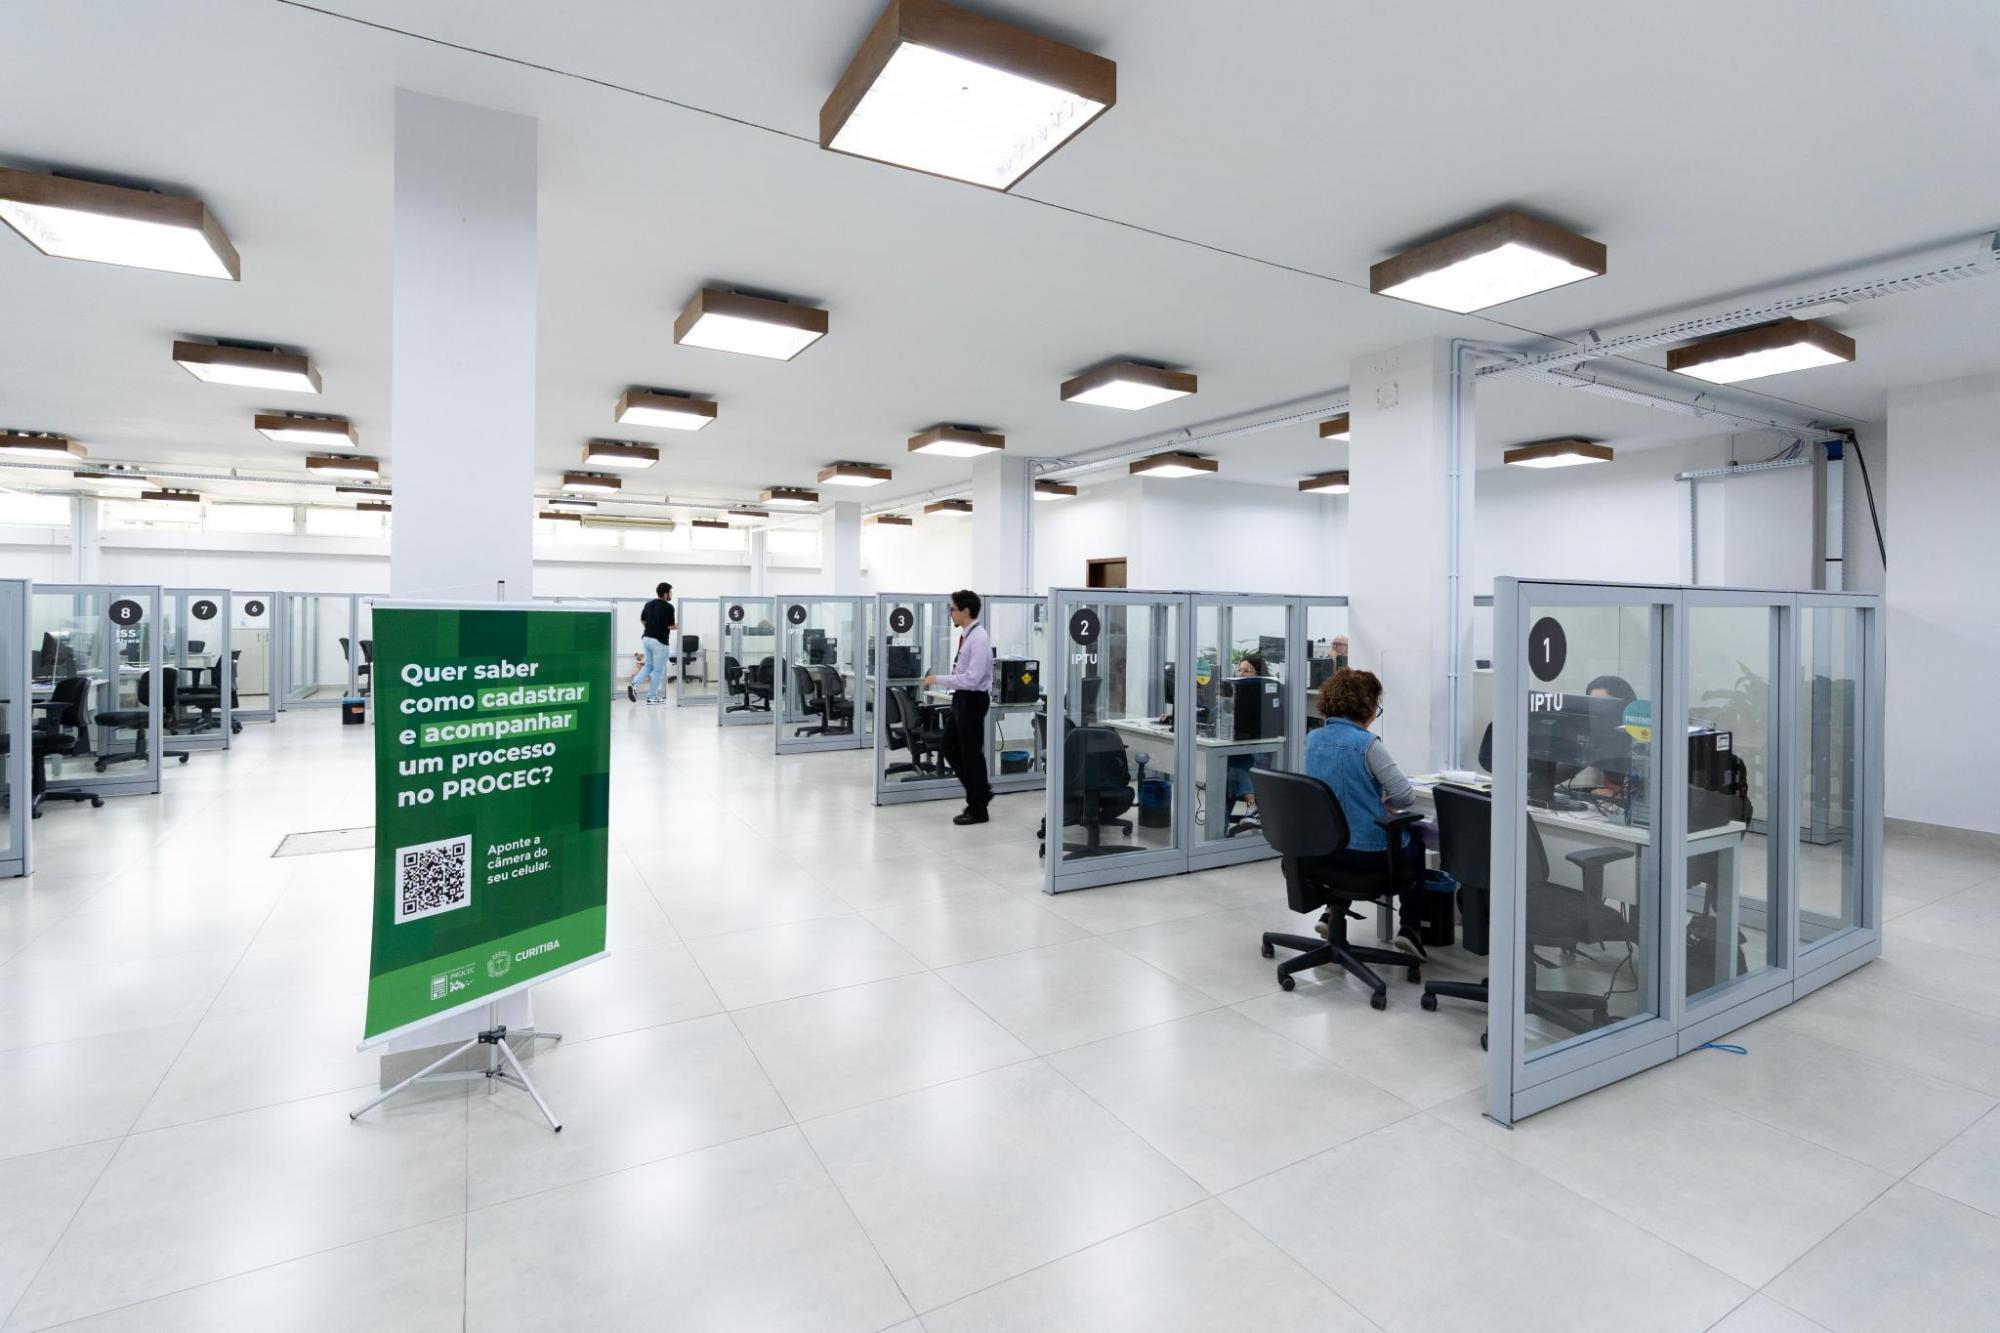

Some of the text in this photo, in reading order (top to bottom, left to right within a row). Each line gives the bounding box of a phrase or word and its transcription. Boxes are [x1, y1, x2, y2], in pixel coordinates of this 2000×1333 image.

[120, 607, 131, 619] 8
[200, 605, 209, 615] 7
[252, 605, 258, 613] 6
[733, 610, 740, 618] 5
[793, 611, 800, 619] 4
[897, 615, 905, 627] 3
[1080, 619, 1089, 635] 2
[116, 629, 137, 638] ISS
[1071, 653, 1098, 665] IPTU
[1543, 637, 1551, 663] 1
[400, 659, 539, 687] Quer saber
[400, 686, 585, 715] como cadastrar
[1530, 692, 1563, 712] IPTU
[399, 712, 573, 745] e acompanhar
[399, 742, 557, 776] um processo
[398, 766, 554, 808] no PROCEC?
[487, 836, 541, 856] Aponte a
[487, 847, 548, 869] câmera do
[487, 861, 551, 884] seu celular.
[515, 939, 560, 962] CURITIBA
